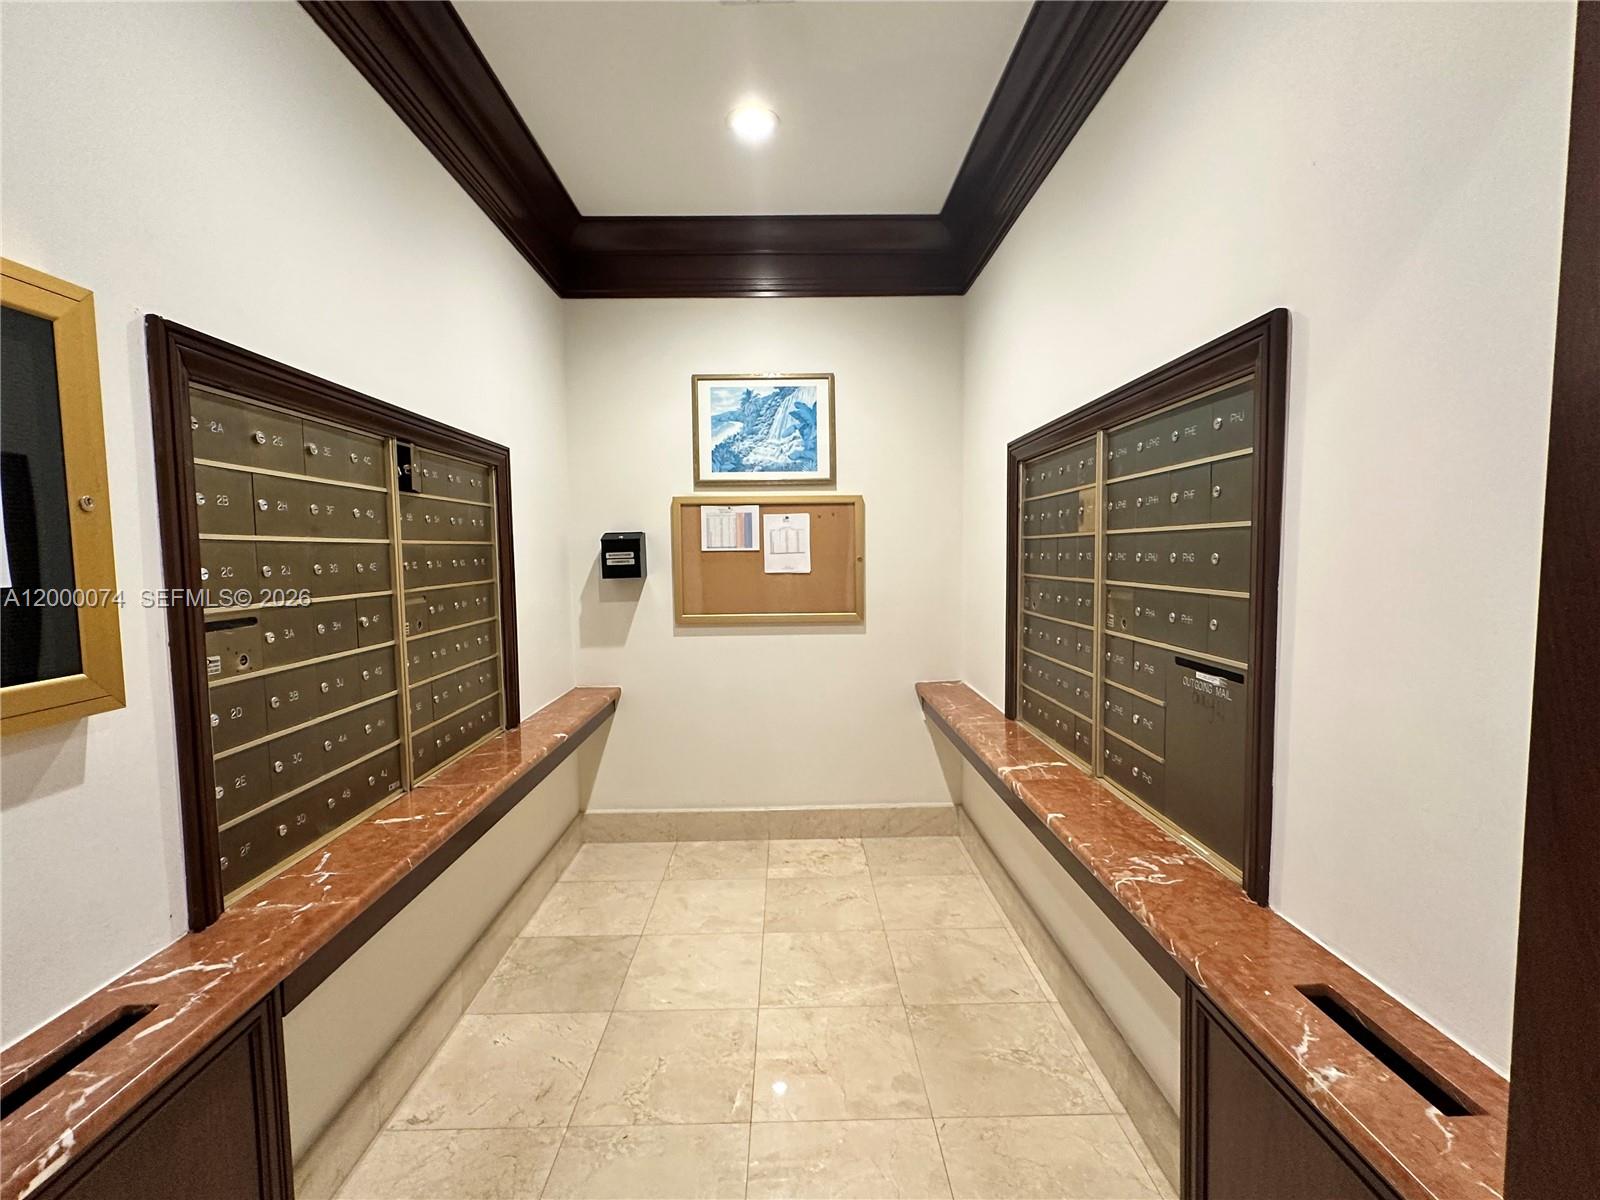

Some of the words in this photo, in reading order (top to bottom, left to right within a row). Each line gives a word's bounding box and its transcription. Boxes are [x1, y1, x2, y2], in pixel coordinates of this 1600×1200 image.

[210, 421, 224, 433] 2A
[216, 495, 230, 506] 2B
[276, 500, 288, 512] 2H
[284, 630, 295, 640] 3A
[1182, 674, 1214, 694] OUTGOING
[1216, 686, 1233, 702] MAIL
[230, 706, 243, 719] 2D
